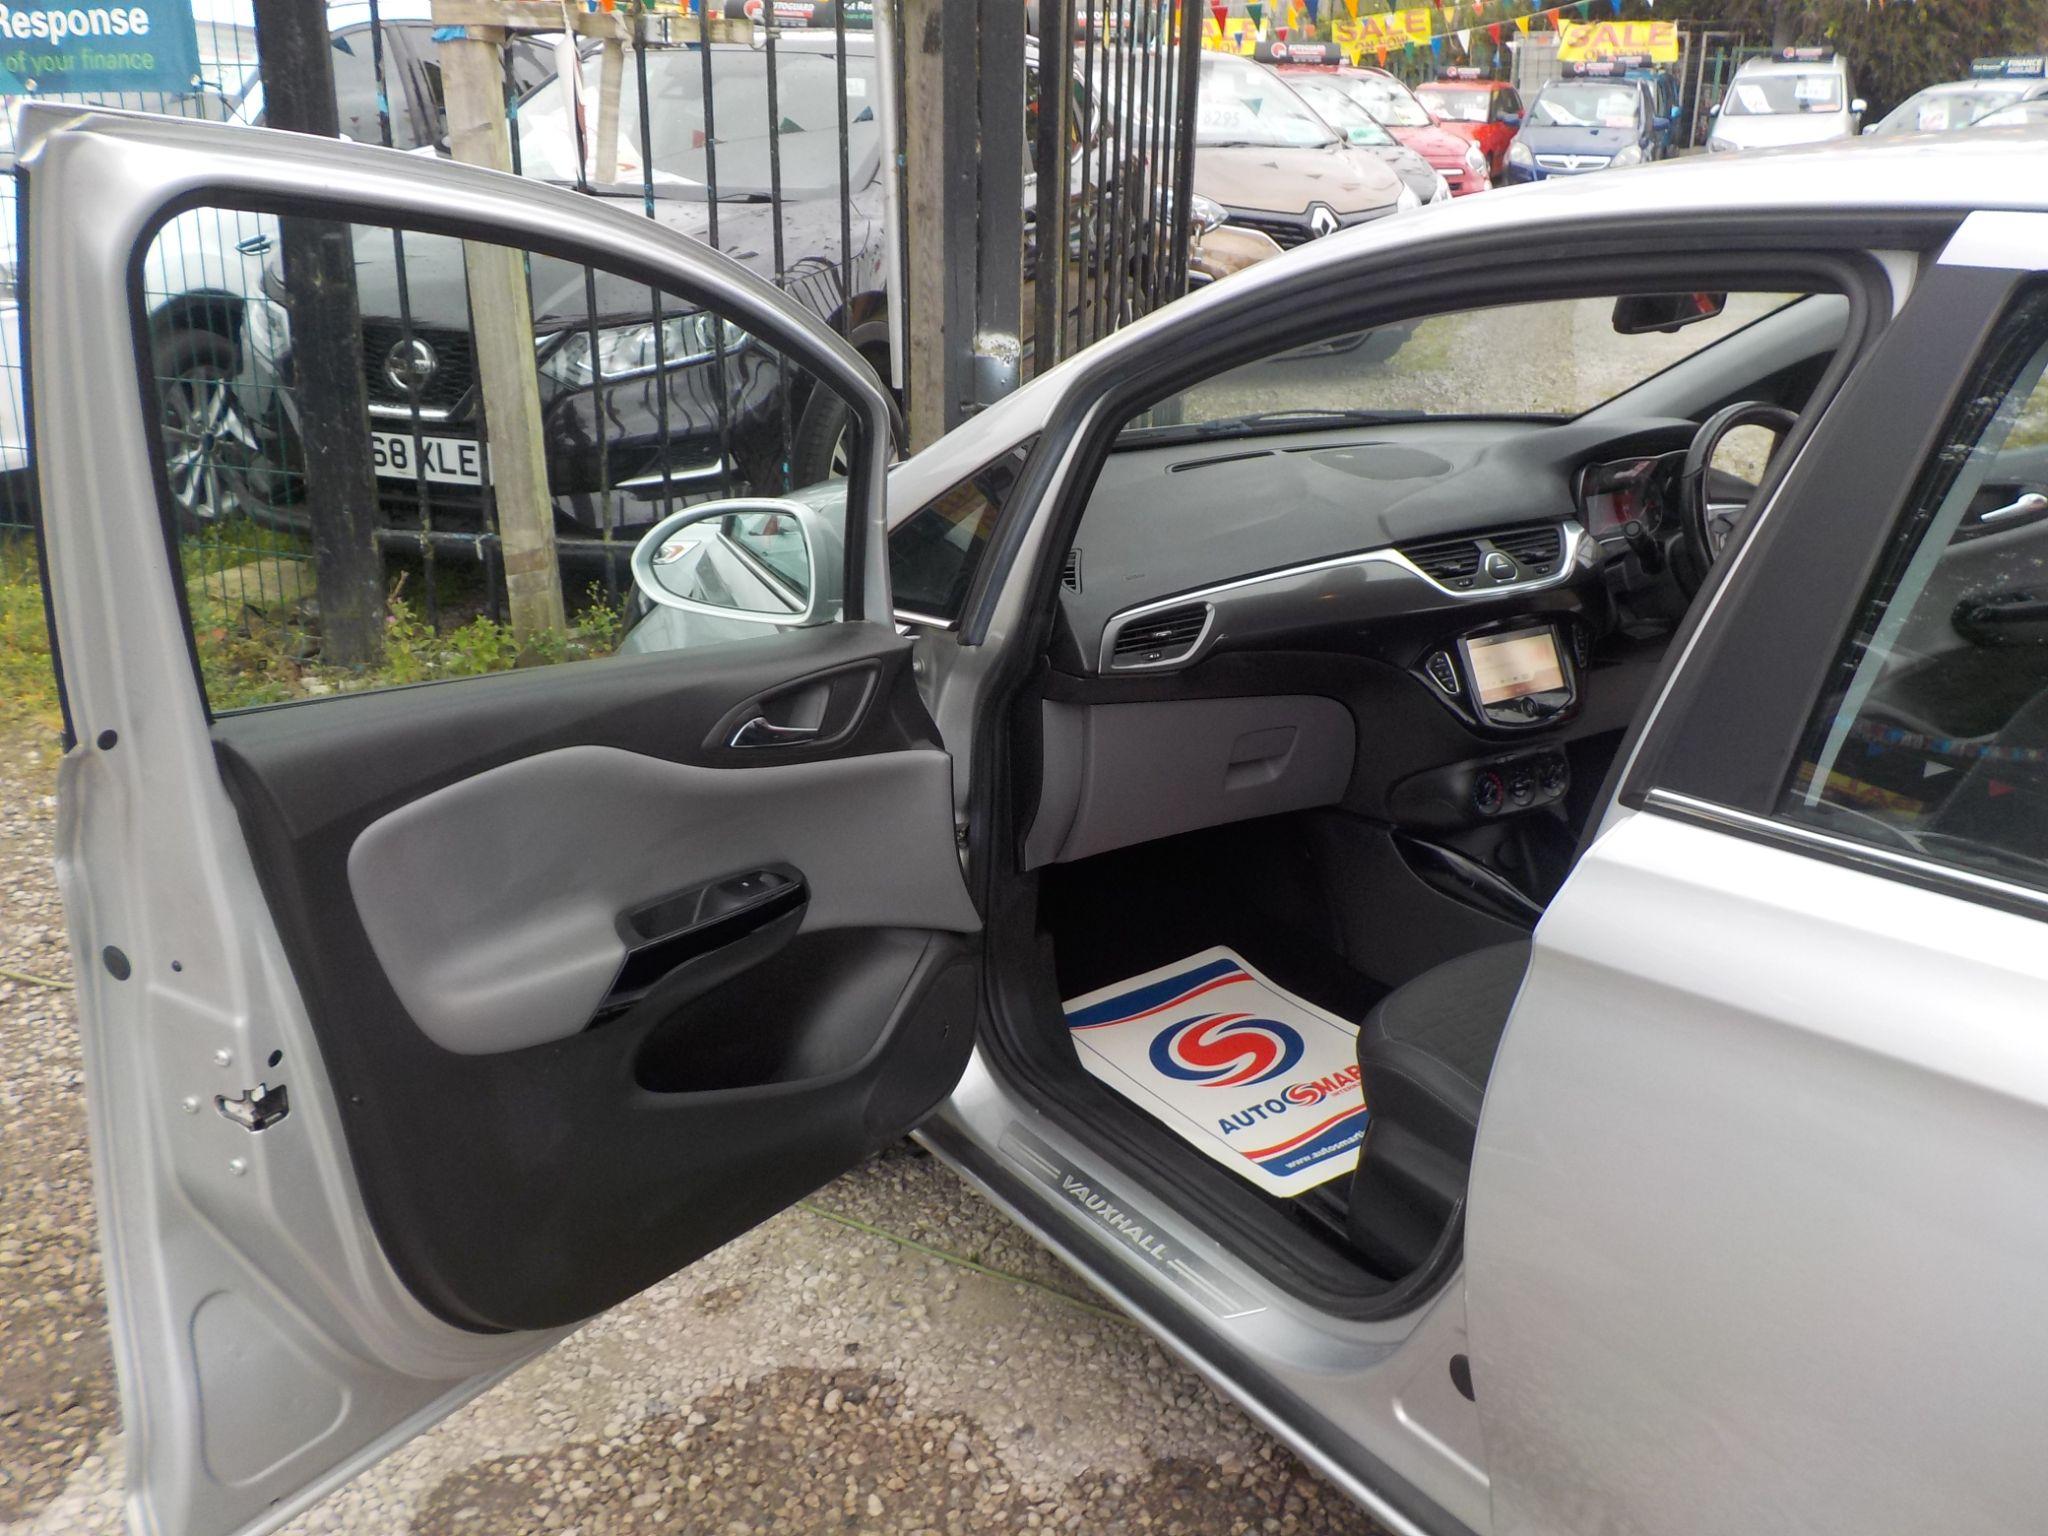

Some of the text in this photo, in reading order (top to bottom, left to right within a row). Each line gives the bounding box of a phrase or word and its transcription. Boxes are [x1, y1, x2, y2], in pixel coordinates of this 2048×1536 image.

[0, 3, 149, 46] Response
[1337, 9, 1426, 42] SALE
[1567, 23, 1673, 48] SALE
[6, 48, 155, 77] of your finance
[1062, 1174, 1168, 1261] VAUXHALL
